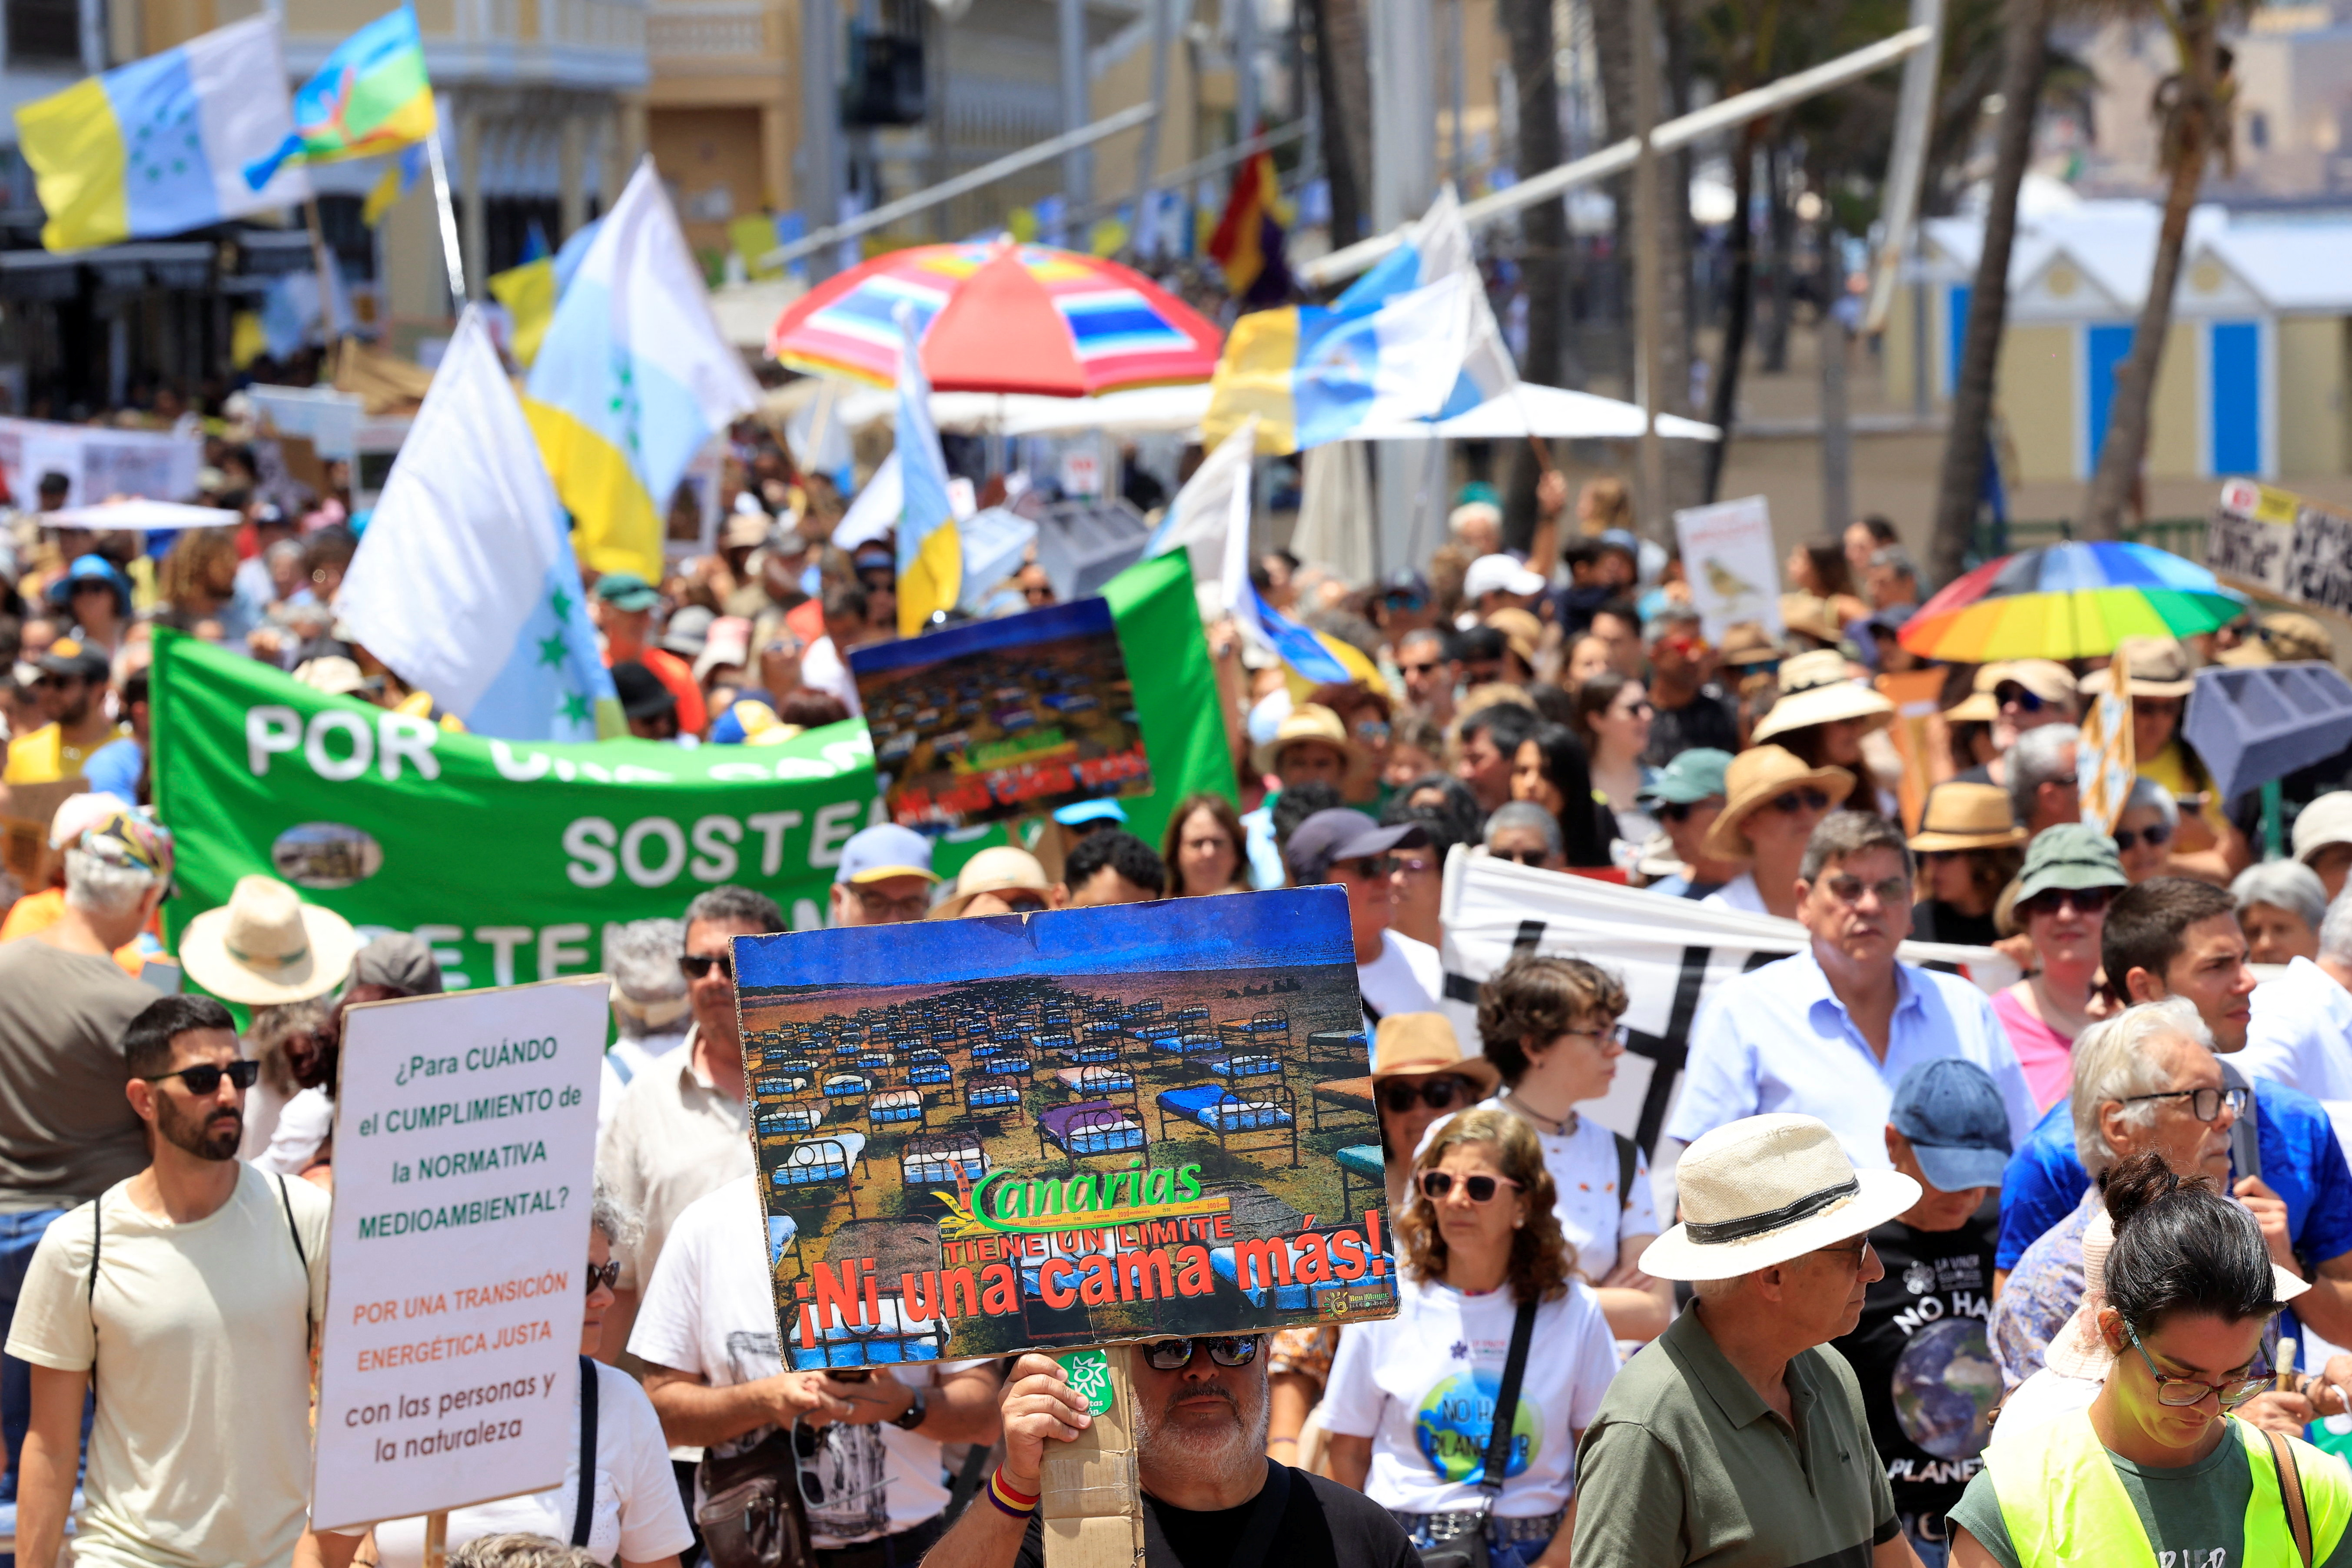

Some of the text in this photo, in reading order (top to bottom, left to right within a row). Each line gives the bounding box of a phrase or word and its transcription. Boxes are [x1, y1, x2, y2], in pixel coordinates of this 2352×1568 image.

[245, 705, 442, 781] POR
[562, 799, 889, 889] SOSTE
[395, 1037, 557, 1086] ¿Para CUÁNDO
[359, 1085, 581, 1136] el CUMPLIMIENTO de
[392, 1140, 547, 1184] la NORMATIVA
[359, 1186, 569, 1240] MEDIOAMBIENTAL?
[970, 1159, 1201, 1233] Canarias
[942, 1215, 1235, 1263] TIENE UN LIMITE
[353, 1269, 568, 1325] POR UNA TRANSICIÓN
[795, 1209, 1386, 1350] ¡Ni una cama más!
[1893, 1292, 1991, 1335] NO HA
[358, 1320, 552, 1372] ENERGÉTICA JUSTA
[345, 1372, 556, 1428] con las personas y
[1442, 1399, 1470, 1423] NO
[375, 1419, 522, 1462] la naturaleza
